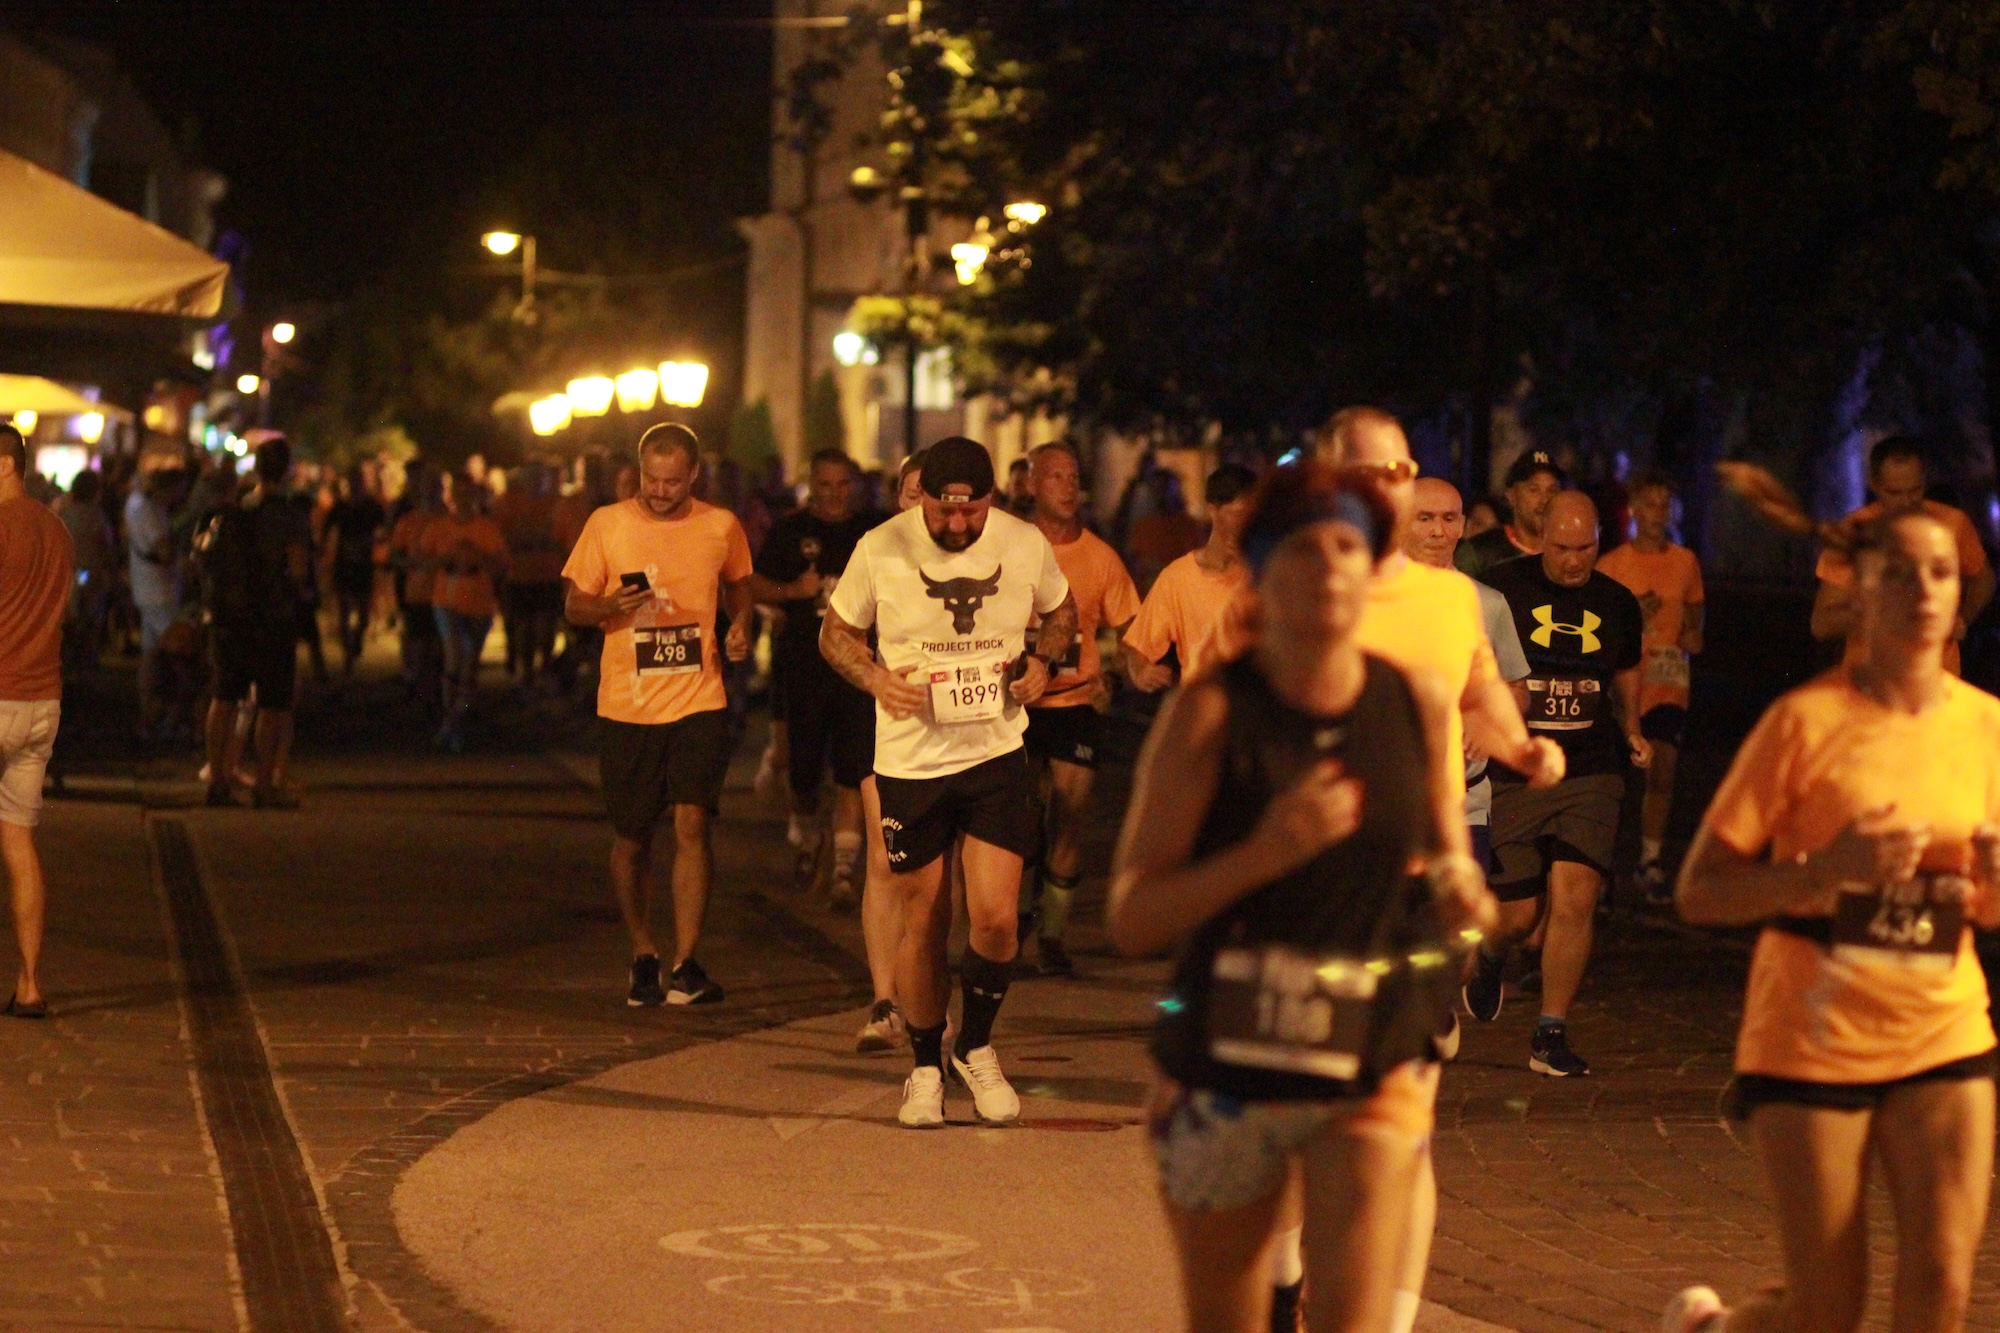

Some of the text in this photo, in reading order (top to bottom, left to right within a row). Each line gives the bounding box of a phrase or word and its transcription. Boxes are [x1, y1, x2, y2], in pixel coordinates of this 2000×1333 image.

[653, 645, 686, 662] 498
[921, 639, 1004, 652] PROJECT ROCK
[963, 676, 981, 684] RUN
[949, 683, 998, 707] 1899
[1544, 697, 1581, 716] 316
